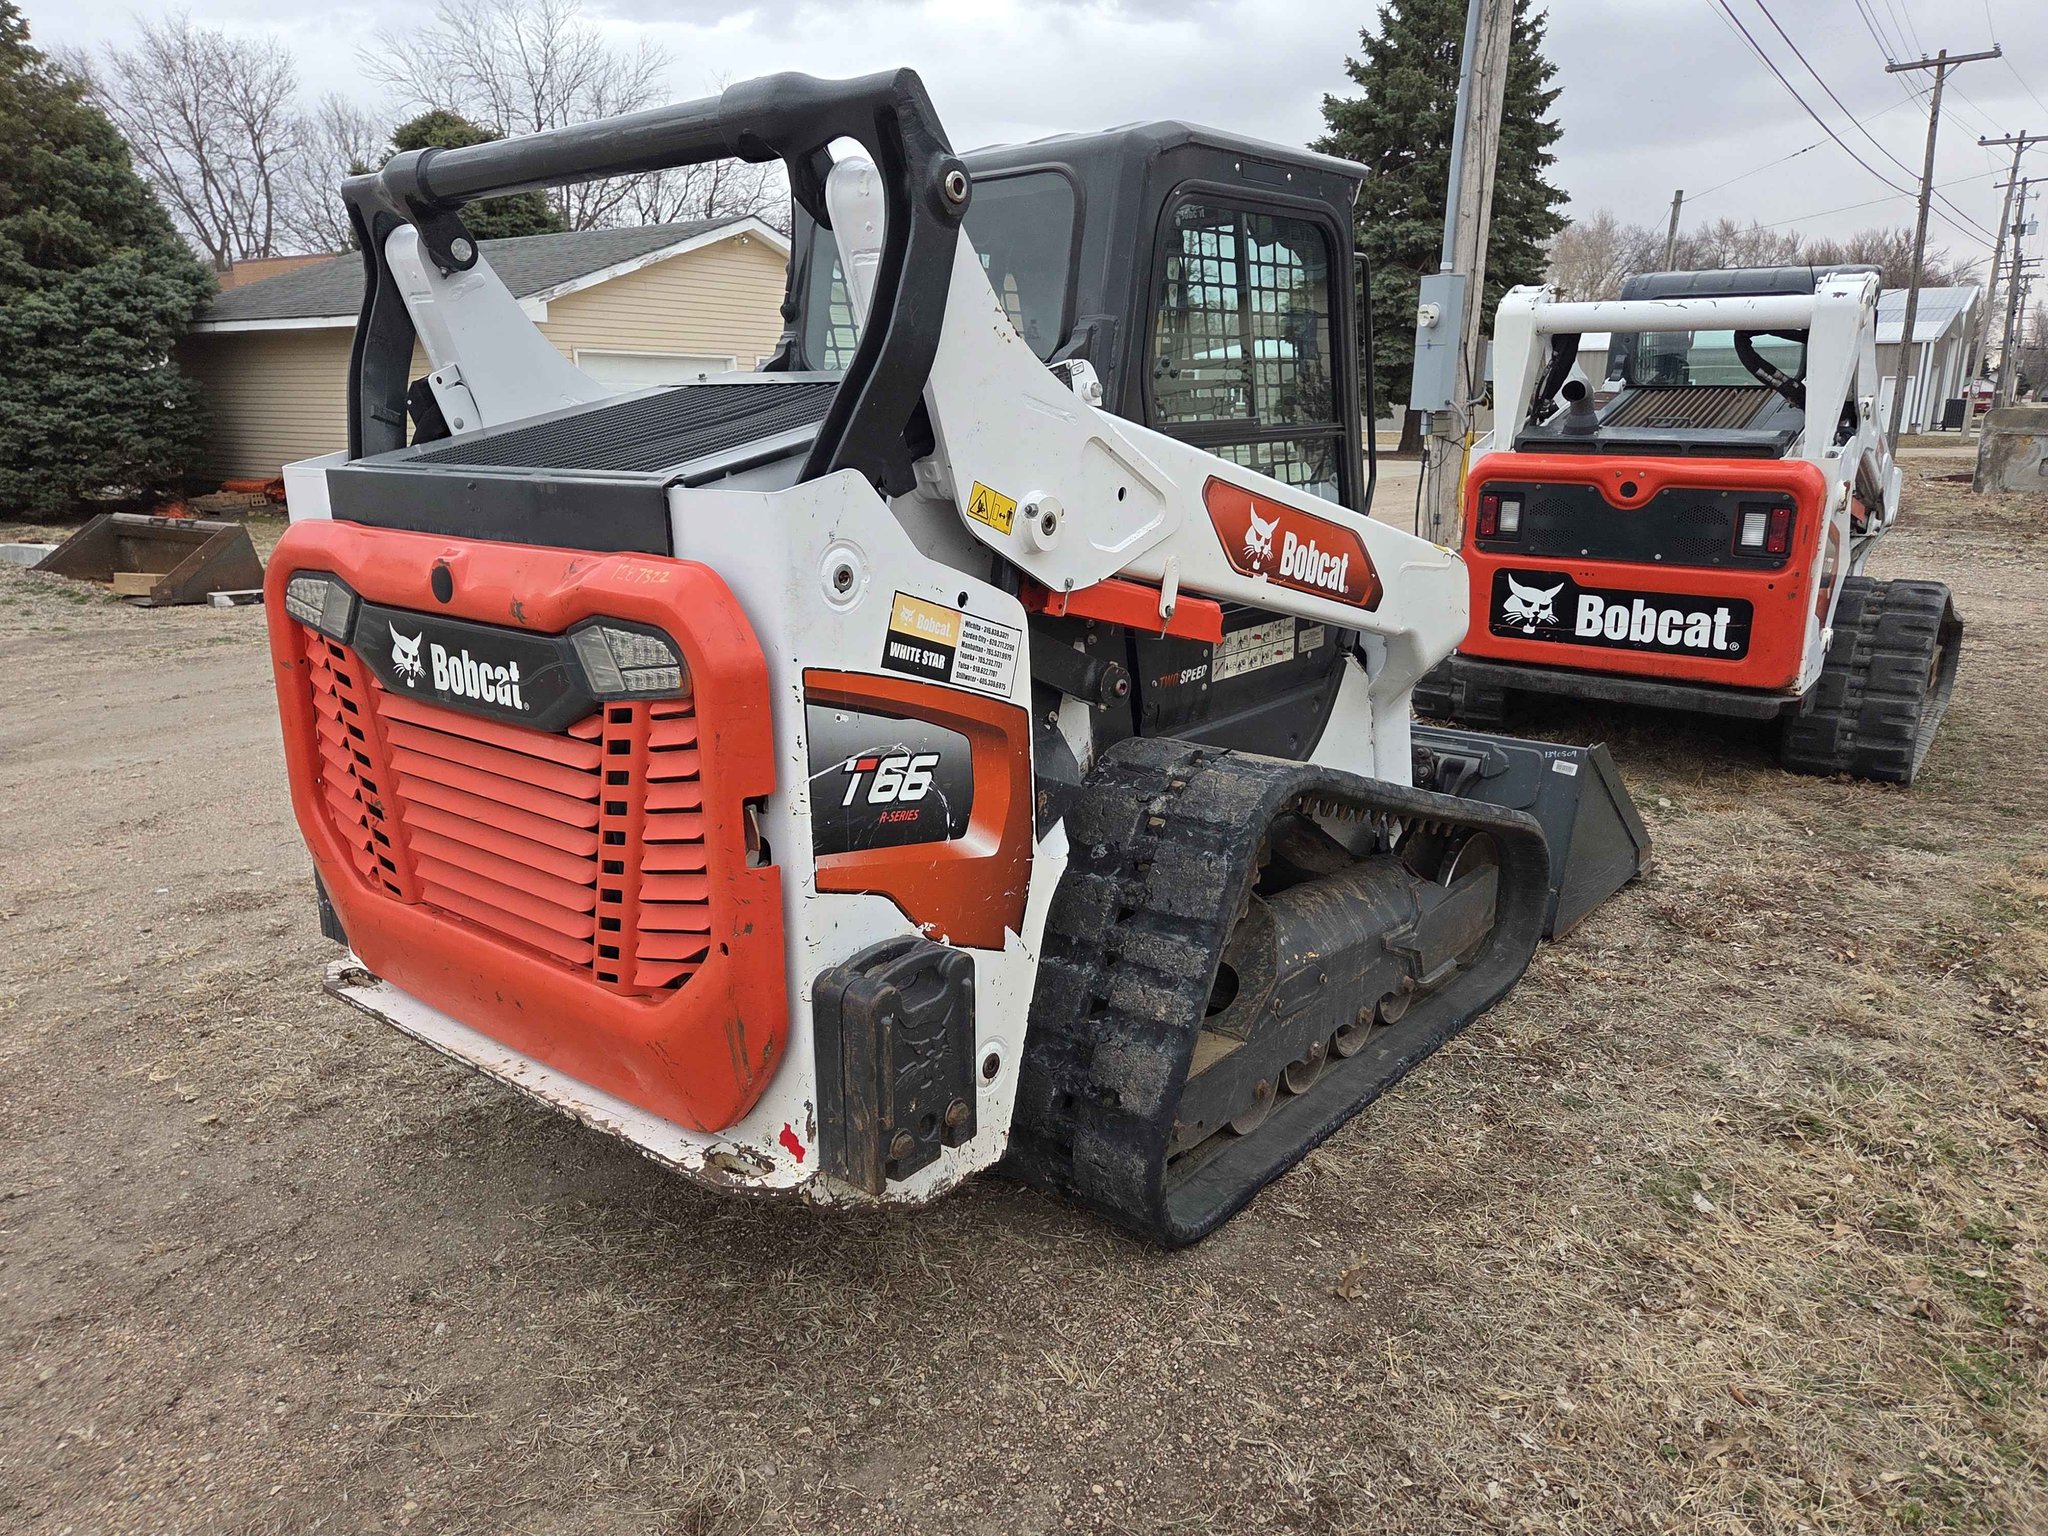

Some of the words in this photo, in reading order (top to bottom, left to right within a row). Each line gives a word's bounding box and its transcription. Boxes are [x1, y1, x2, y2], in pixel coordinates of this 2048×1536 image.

[1279, 530, 1349, 593] Bobcat
[916, 613, 951, 637] Bobcat
[1574, 594, 1731, 651] Bobcat
[961, 641, 984, 654] Manhattan
[962, 630, 978, 643] Garden
[978, 634, 987, 645] City
[889, 641, 921, 663] WHITE
[921, 651, 946, 670] STAR
[958, 661, 970, 671] Tulsa
[959, 651, 975, 663] Topeka
[430, 643, 523, 710] Bobcat
[956, 671, 977, 683] Stillwater
[1160, 672, 1179, 688] TWO
[1179, 664, 1208, 685] SPEED
[842, 754, 940, 807] T66
[879, 809, 920, 825] R-SERIES
